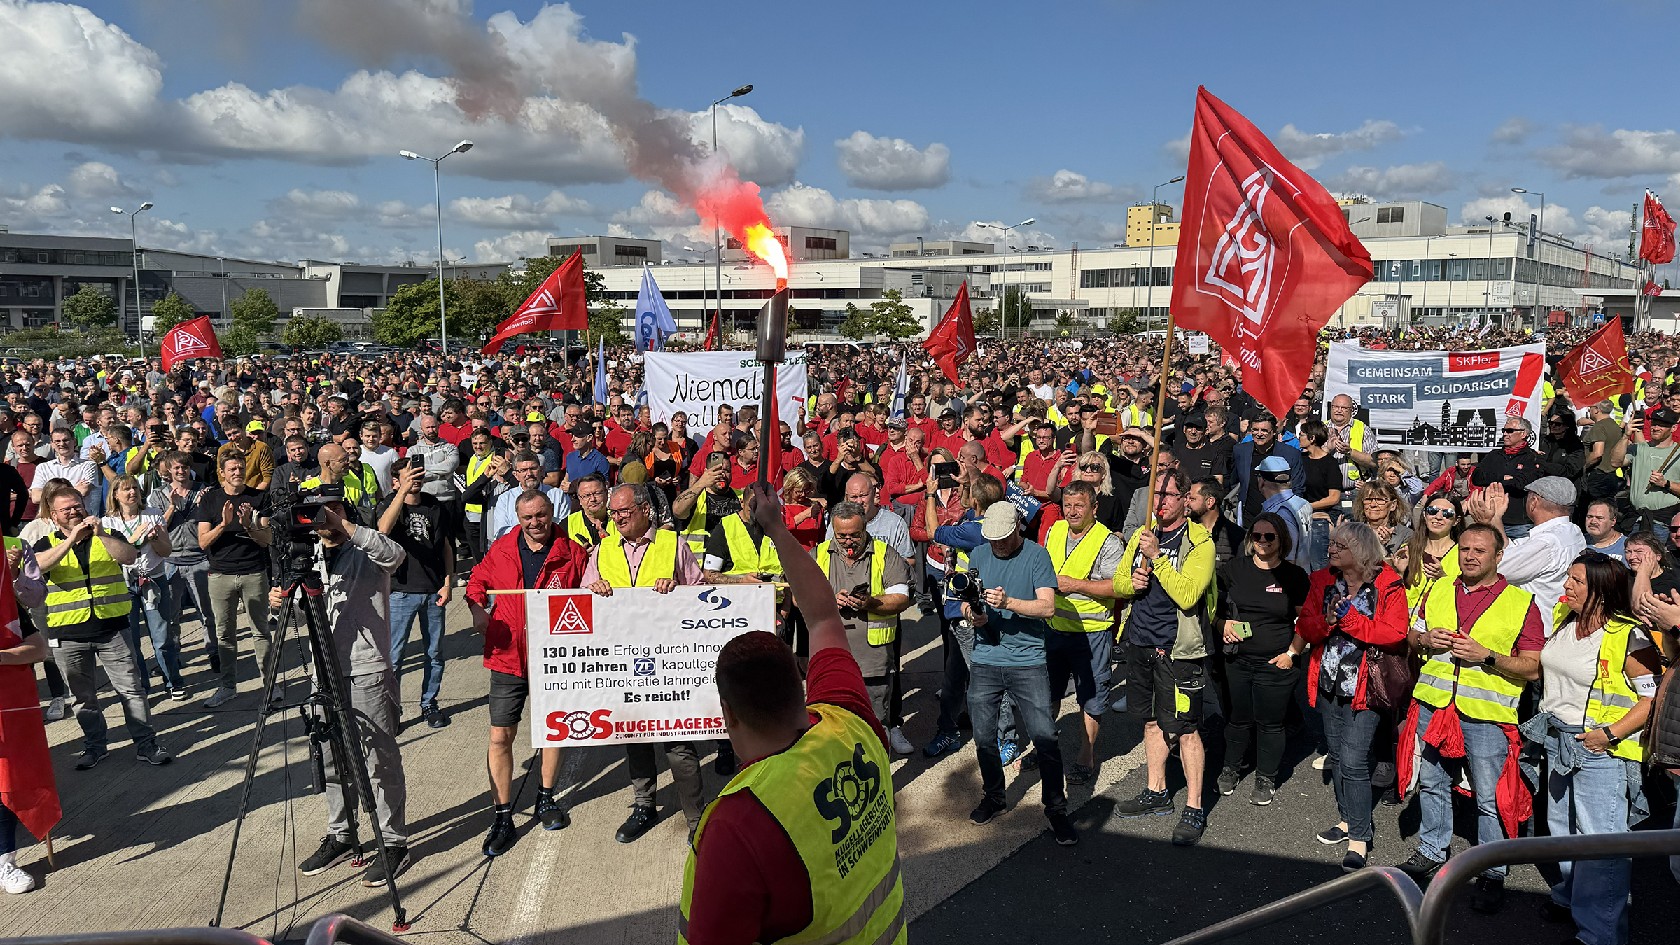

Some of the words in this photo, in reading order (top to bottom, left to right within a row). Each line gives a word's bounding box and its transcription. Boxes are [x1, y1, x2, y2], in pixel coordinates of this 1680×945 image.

[1357, 367, 1433, 378] GEMEINSAM
[669, 371, 766, 403] Niemal
[1424, 379, 1509, 395] SOLIDARISCH
[1367, 393, 1406, 404] STARK
[681, 618, 749, 629] SACHS
[543, 647, 567, 659] 130
[571, 645, 610, 658] Jahre
[614, 644, 651, 657] Erfolg
[654, 643, 689, 654] durch
[694, 642, 722, 653] Inno
[544, 663, 558, 674] In
[562, 662, 577, 673] 10
[580, 661, 628, 673] Jahren
[662, 659, 716, 671] kaputtge
[544, 680, 568, 690] und
[572, 678, 592, 690] mit
[595, 677, 660, 688] Bürokratie
[623, 692, 642, 703] Es
[645, 690, 690, 702] reicht!
[545, 709, 614, 741] SOS
[615, 717, 724, 732] KUGELLAGERS
